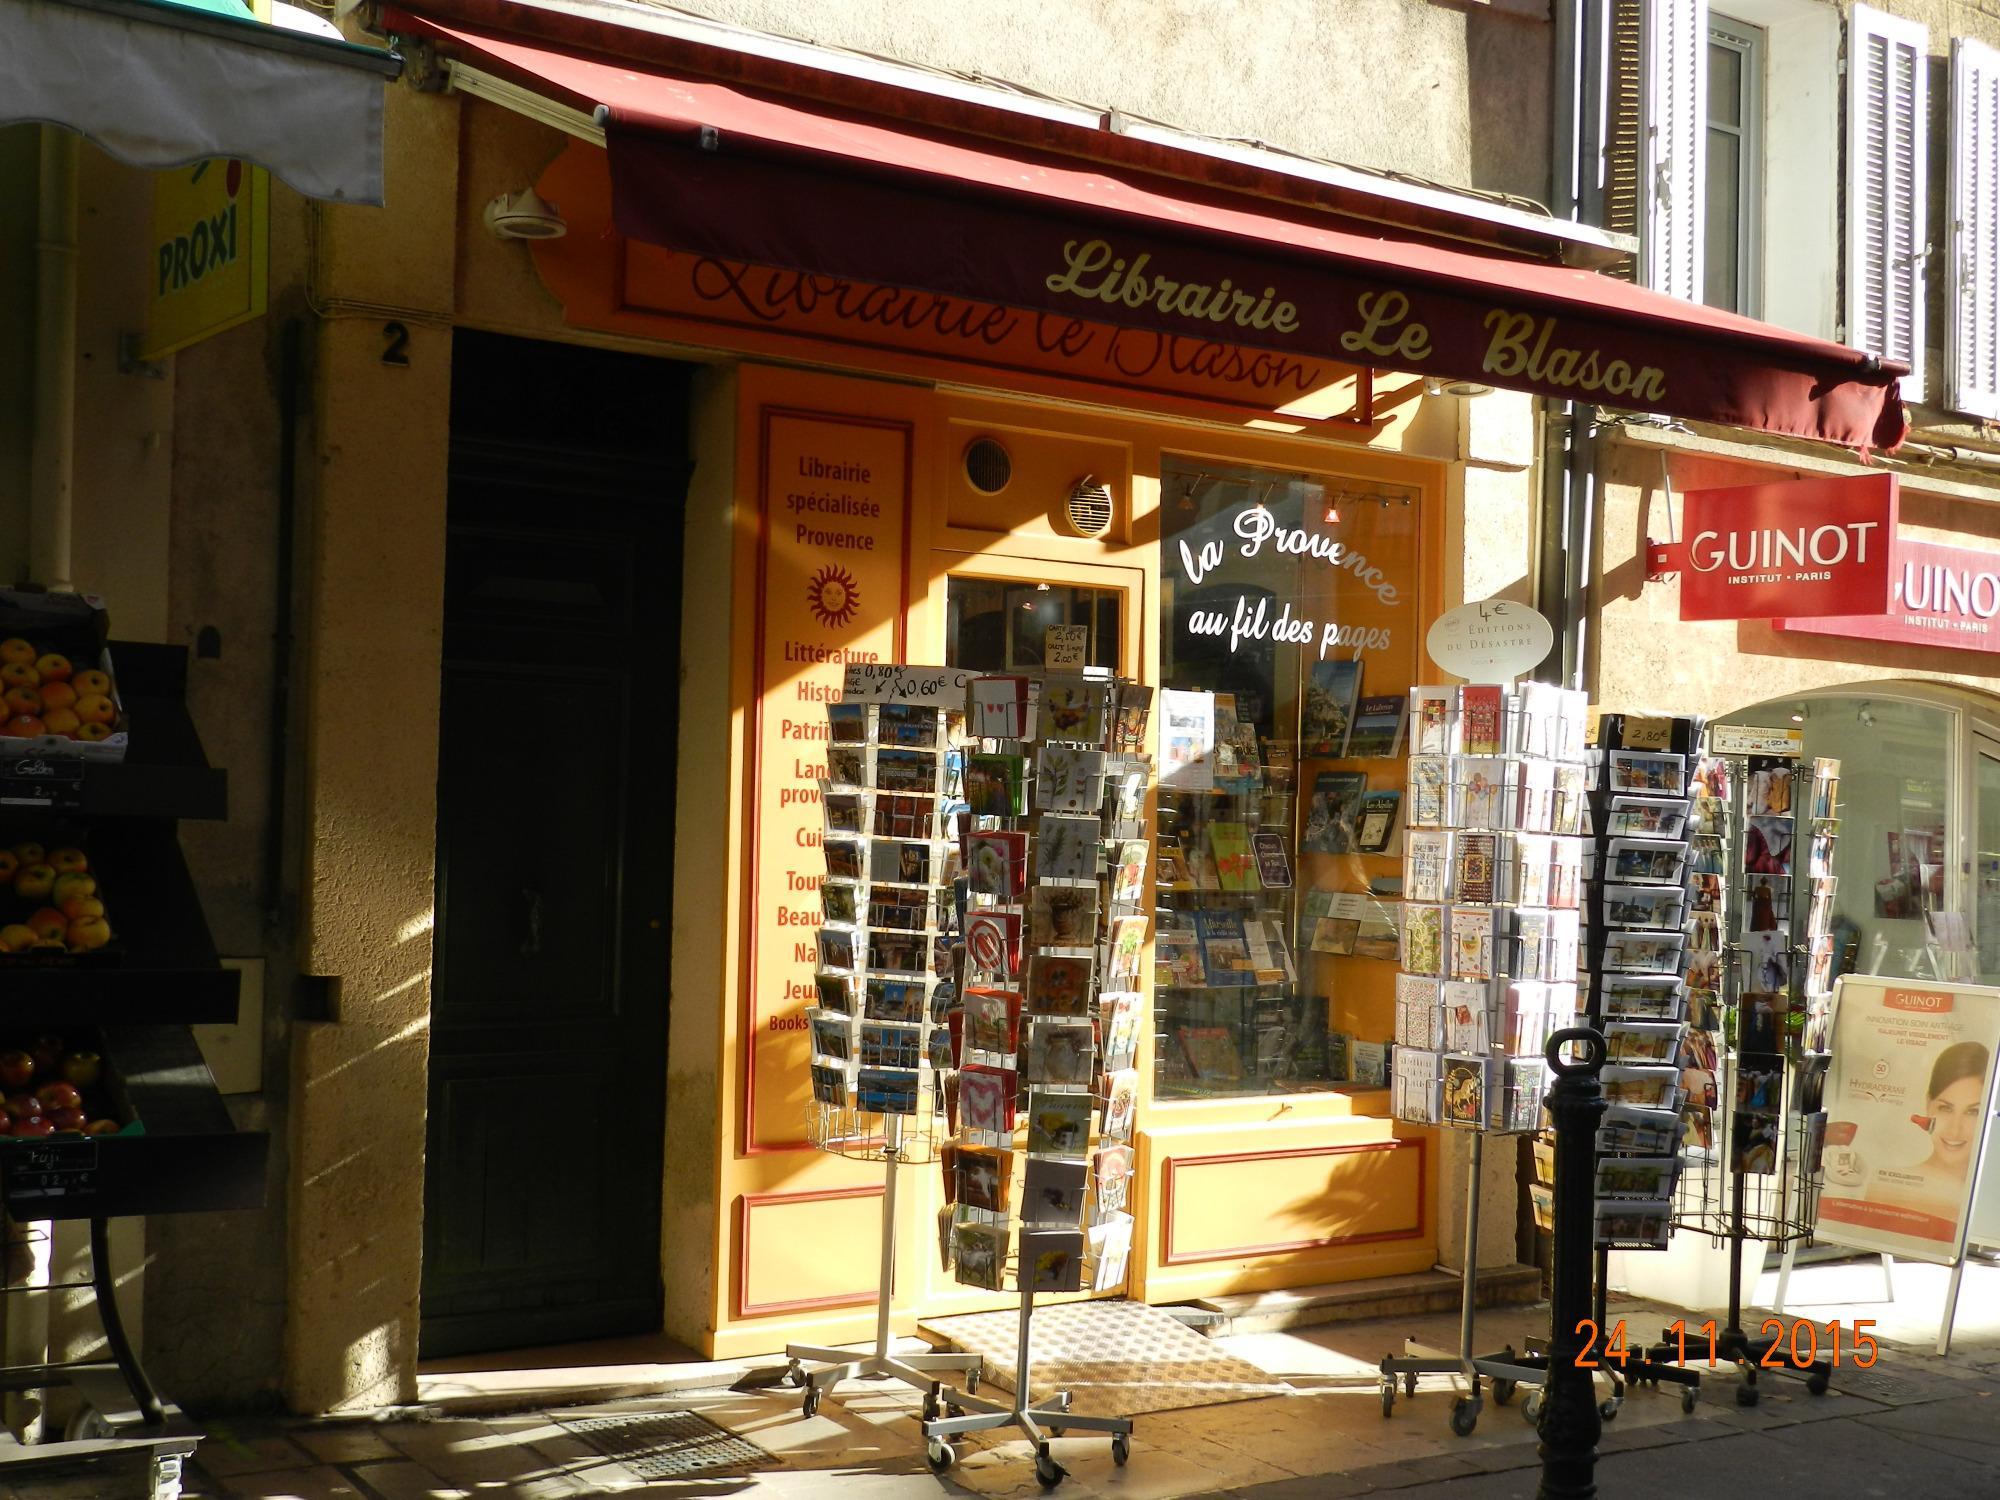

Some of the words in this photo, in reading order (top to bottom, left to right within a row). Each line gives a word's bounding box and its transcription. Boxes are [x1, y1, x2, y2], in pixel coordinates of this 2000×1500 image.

[160, 202, 237, 295] PROXI
[1046, 239, 1299, 333] Librairie
[1340, 290, 1432, 361] Le
[1481, 308, 1666, 402] Blason
[383, 321, 409, 363] 2
[799, 456, 871, 484] Librairie
[786, 491, 880, 518] spécialisée
[796, 523, 874, 551] Provence
[1688, 522, 1878, 572] GUINOT
[1233, 508, 1400, 605] Provence
[1728, 574, 1782, 585] INSTITUT
[1795, 571, 1831, 582] PARIS
[1894, 560, 2000, 619] UINO
[1188, 609, 1228, 637] au
[1230, 595, 1269, 653] fil
[1272, 602, 1313, 643] des
[1319, 622, 1391, 661] pages
[1904, 614, 1949, 629] INSTITUT
[1960, 620, 1988, 633] PARIS
[784, 640, 879, 665] Littérature
[797, 681, 843, 703] Histo
[1632, 729, 1669, 743] 2,80€
[780, 788, 822, 808] prov
[796, 827, 823, 847] Cui
[795, 943, 817, 962] Na
[1895, 993, 1944, 1009] GUINOT
[770, 1014, 809, 1030] Books
